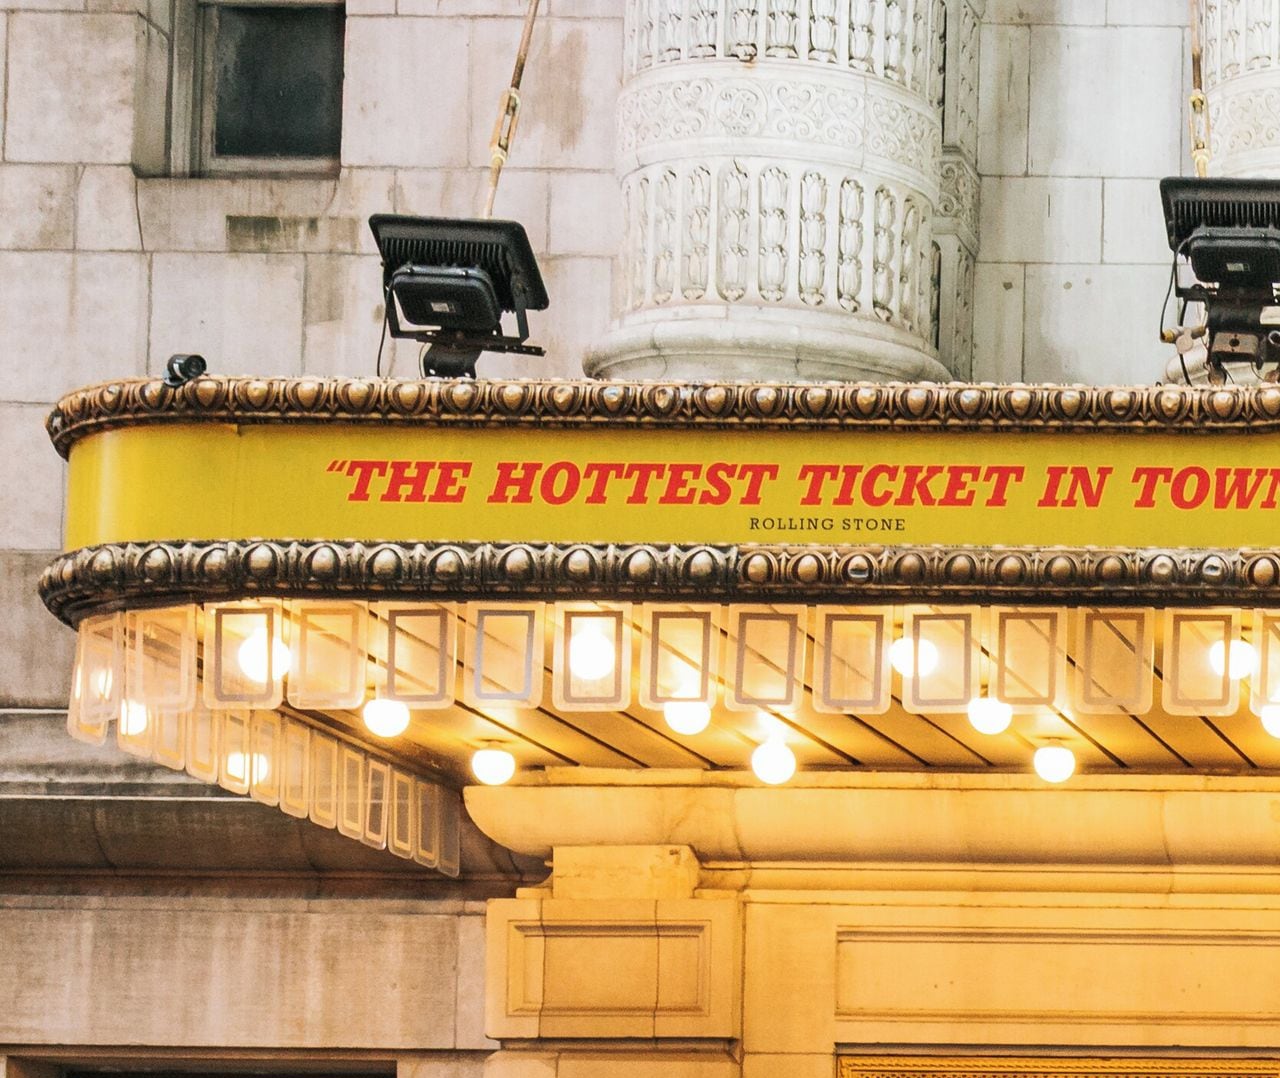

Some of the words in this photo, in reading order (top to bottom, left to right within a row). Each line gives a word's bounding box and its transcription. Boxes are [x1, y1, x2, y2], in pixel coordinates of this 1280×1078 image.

[326, 460, 472, 503] “THE
[487, 461, 778, 506] HOTTEST
[799, 464, 1025, 508] TICKET
[1037, 466, 1114, 508] IN
[750, 518, 834, 531] ROLLING
[842, 518, 906, 531] STONE
